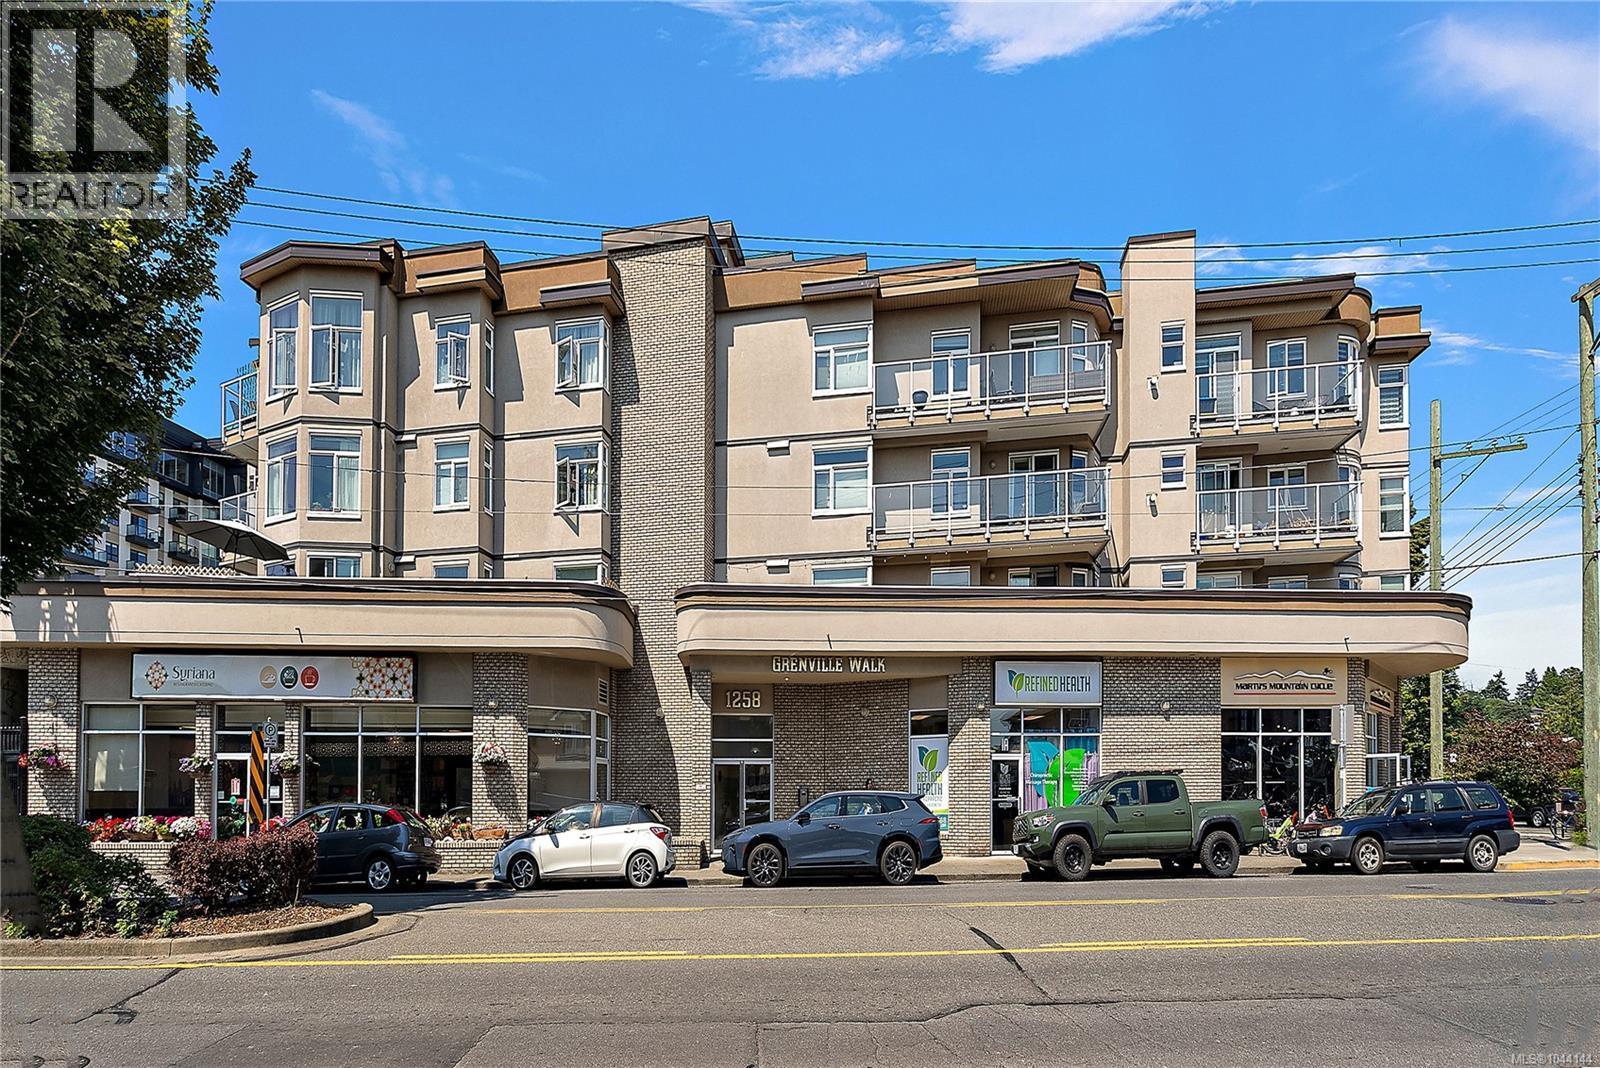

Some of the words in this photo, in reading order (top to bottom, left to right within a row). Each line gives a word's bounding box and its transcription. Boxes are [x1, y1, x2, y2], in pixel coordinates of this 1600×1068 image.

[772, 656, 843, 673] GRENVILLE
[849, 657, 886, 673] WALK
[171, 665, 216, 681] Syriana
[1024, 676, 1059, 692] REFINED
[1060, 676, 1091, 692] HEALTH
[725, 691, 761, 708] 1258
[916, 782, 943, 796] HEALTH
